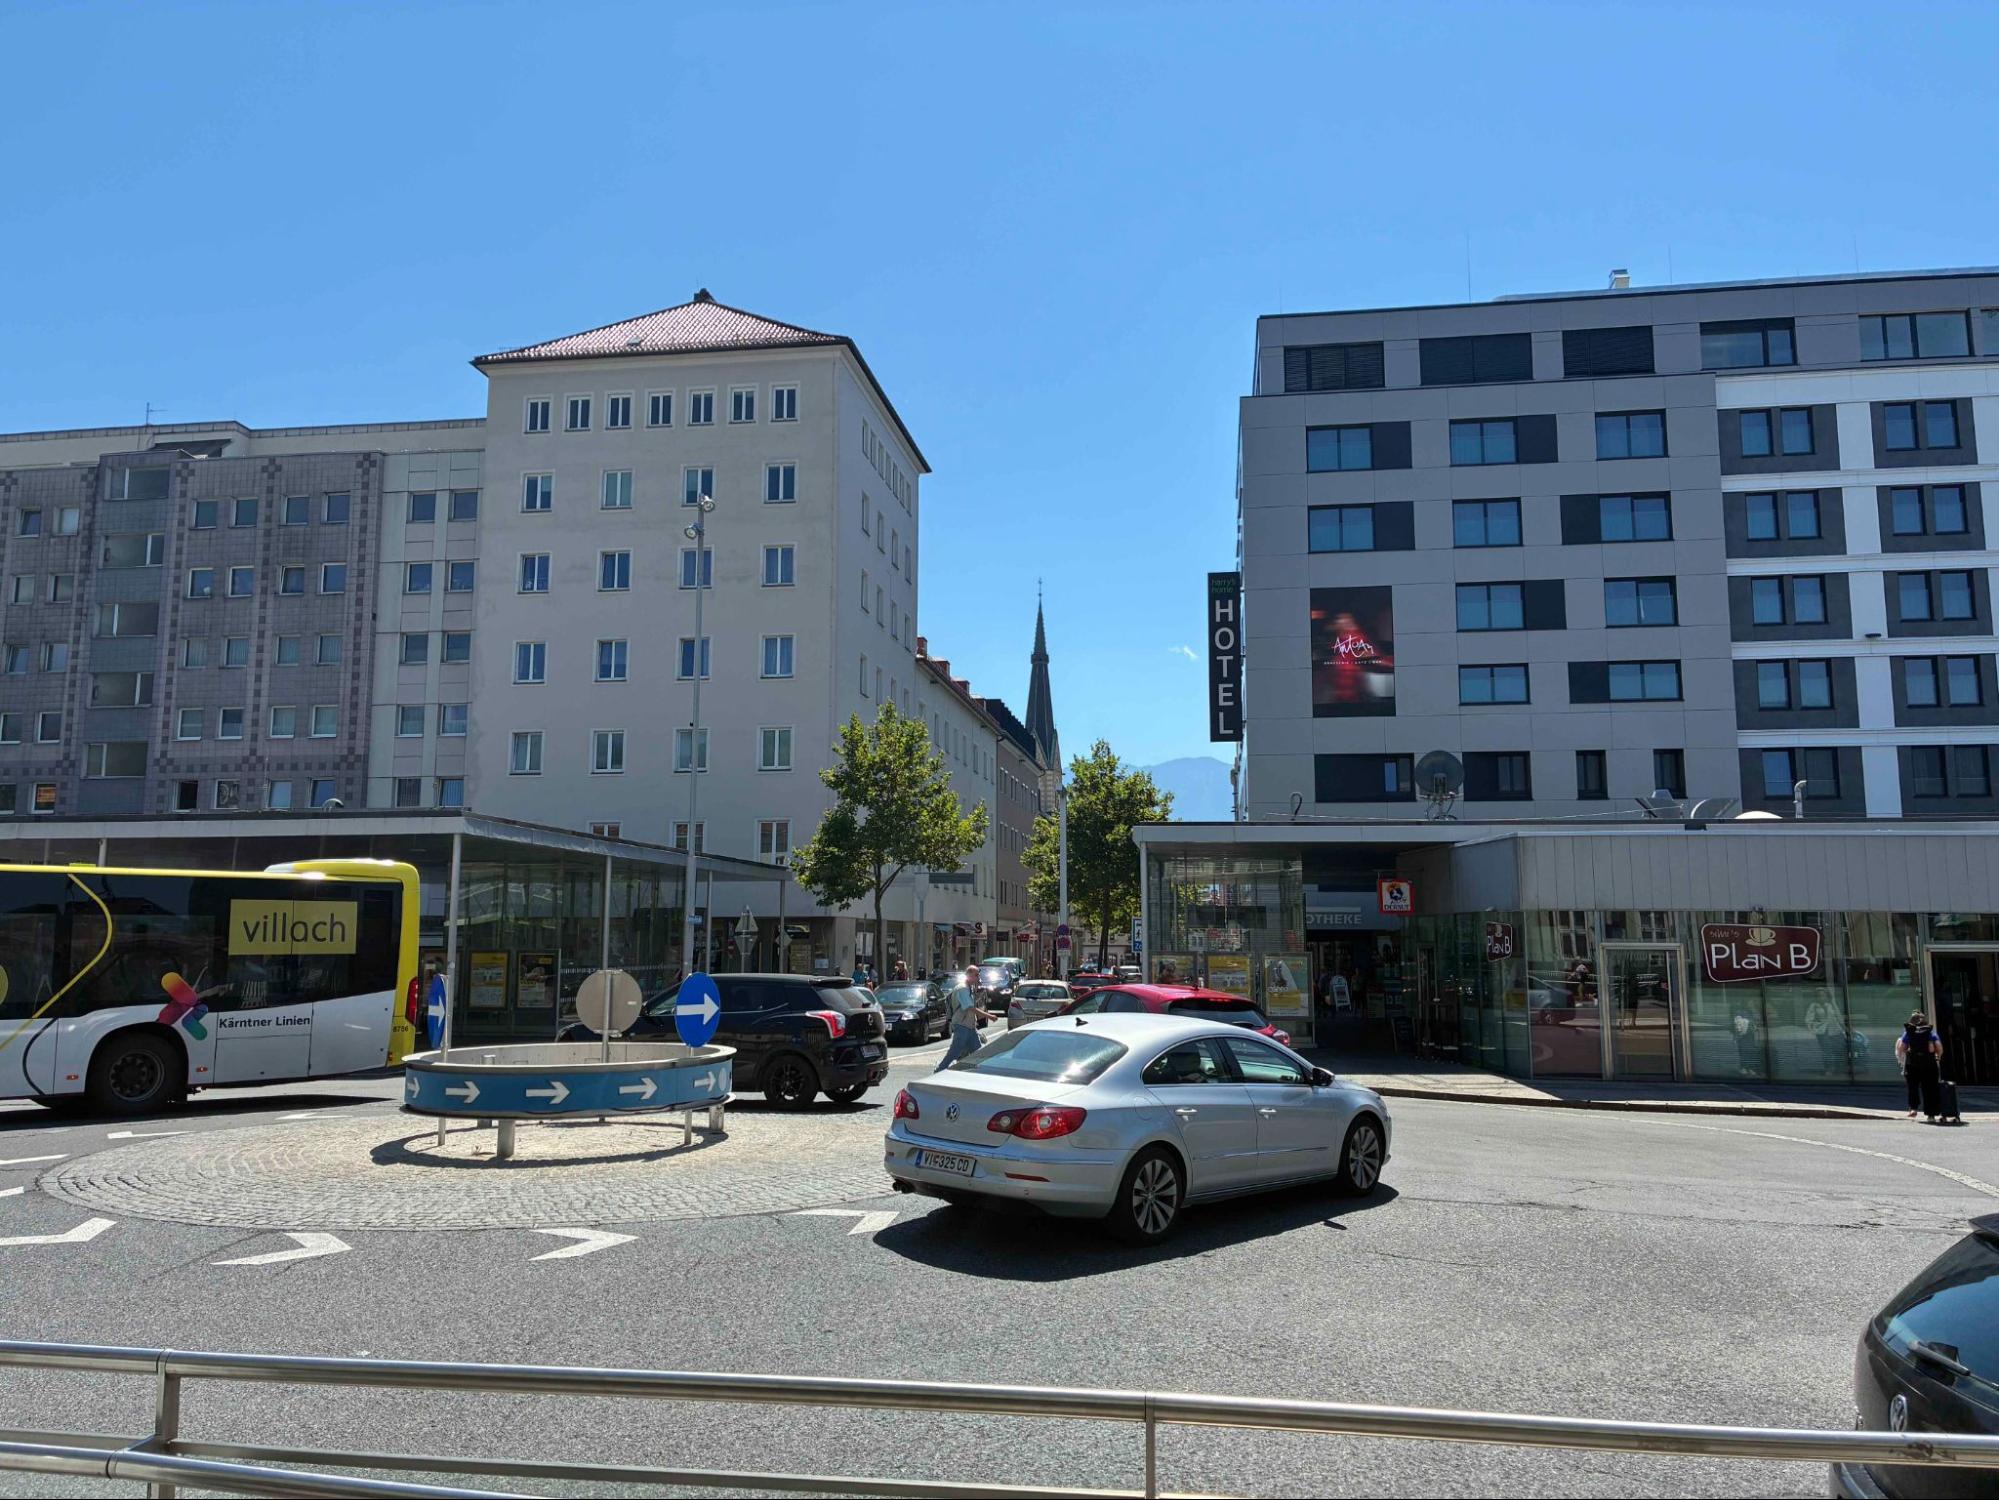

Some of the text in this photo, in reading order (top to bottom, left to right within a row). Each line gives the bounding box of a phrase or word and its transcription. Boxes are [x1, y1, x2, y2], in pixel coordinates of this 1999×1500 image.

[1214, 599, 1235, 735] HOTEL
[242, 911, 347, 943] villach
[1789, 943, 1812, 969] B
[218, 1015, 311, 1029] Kärntner Linien
